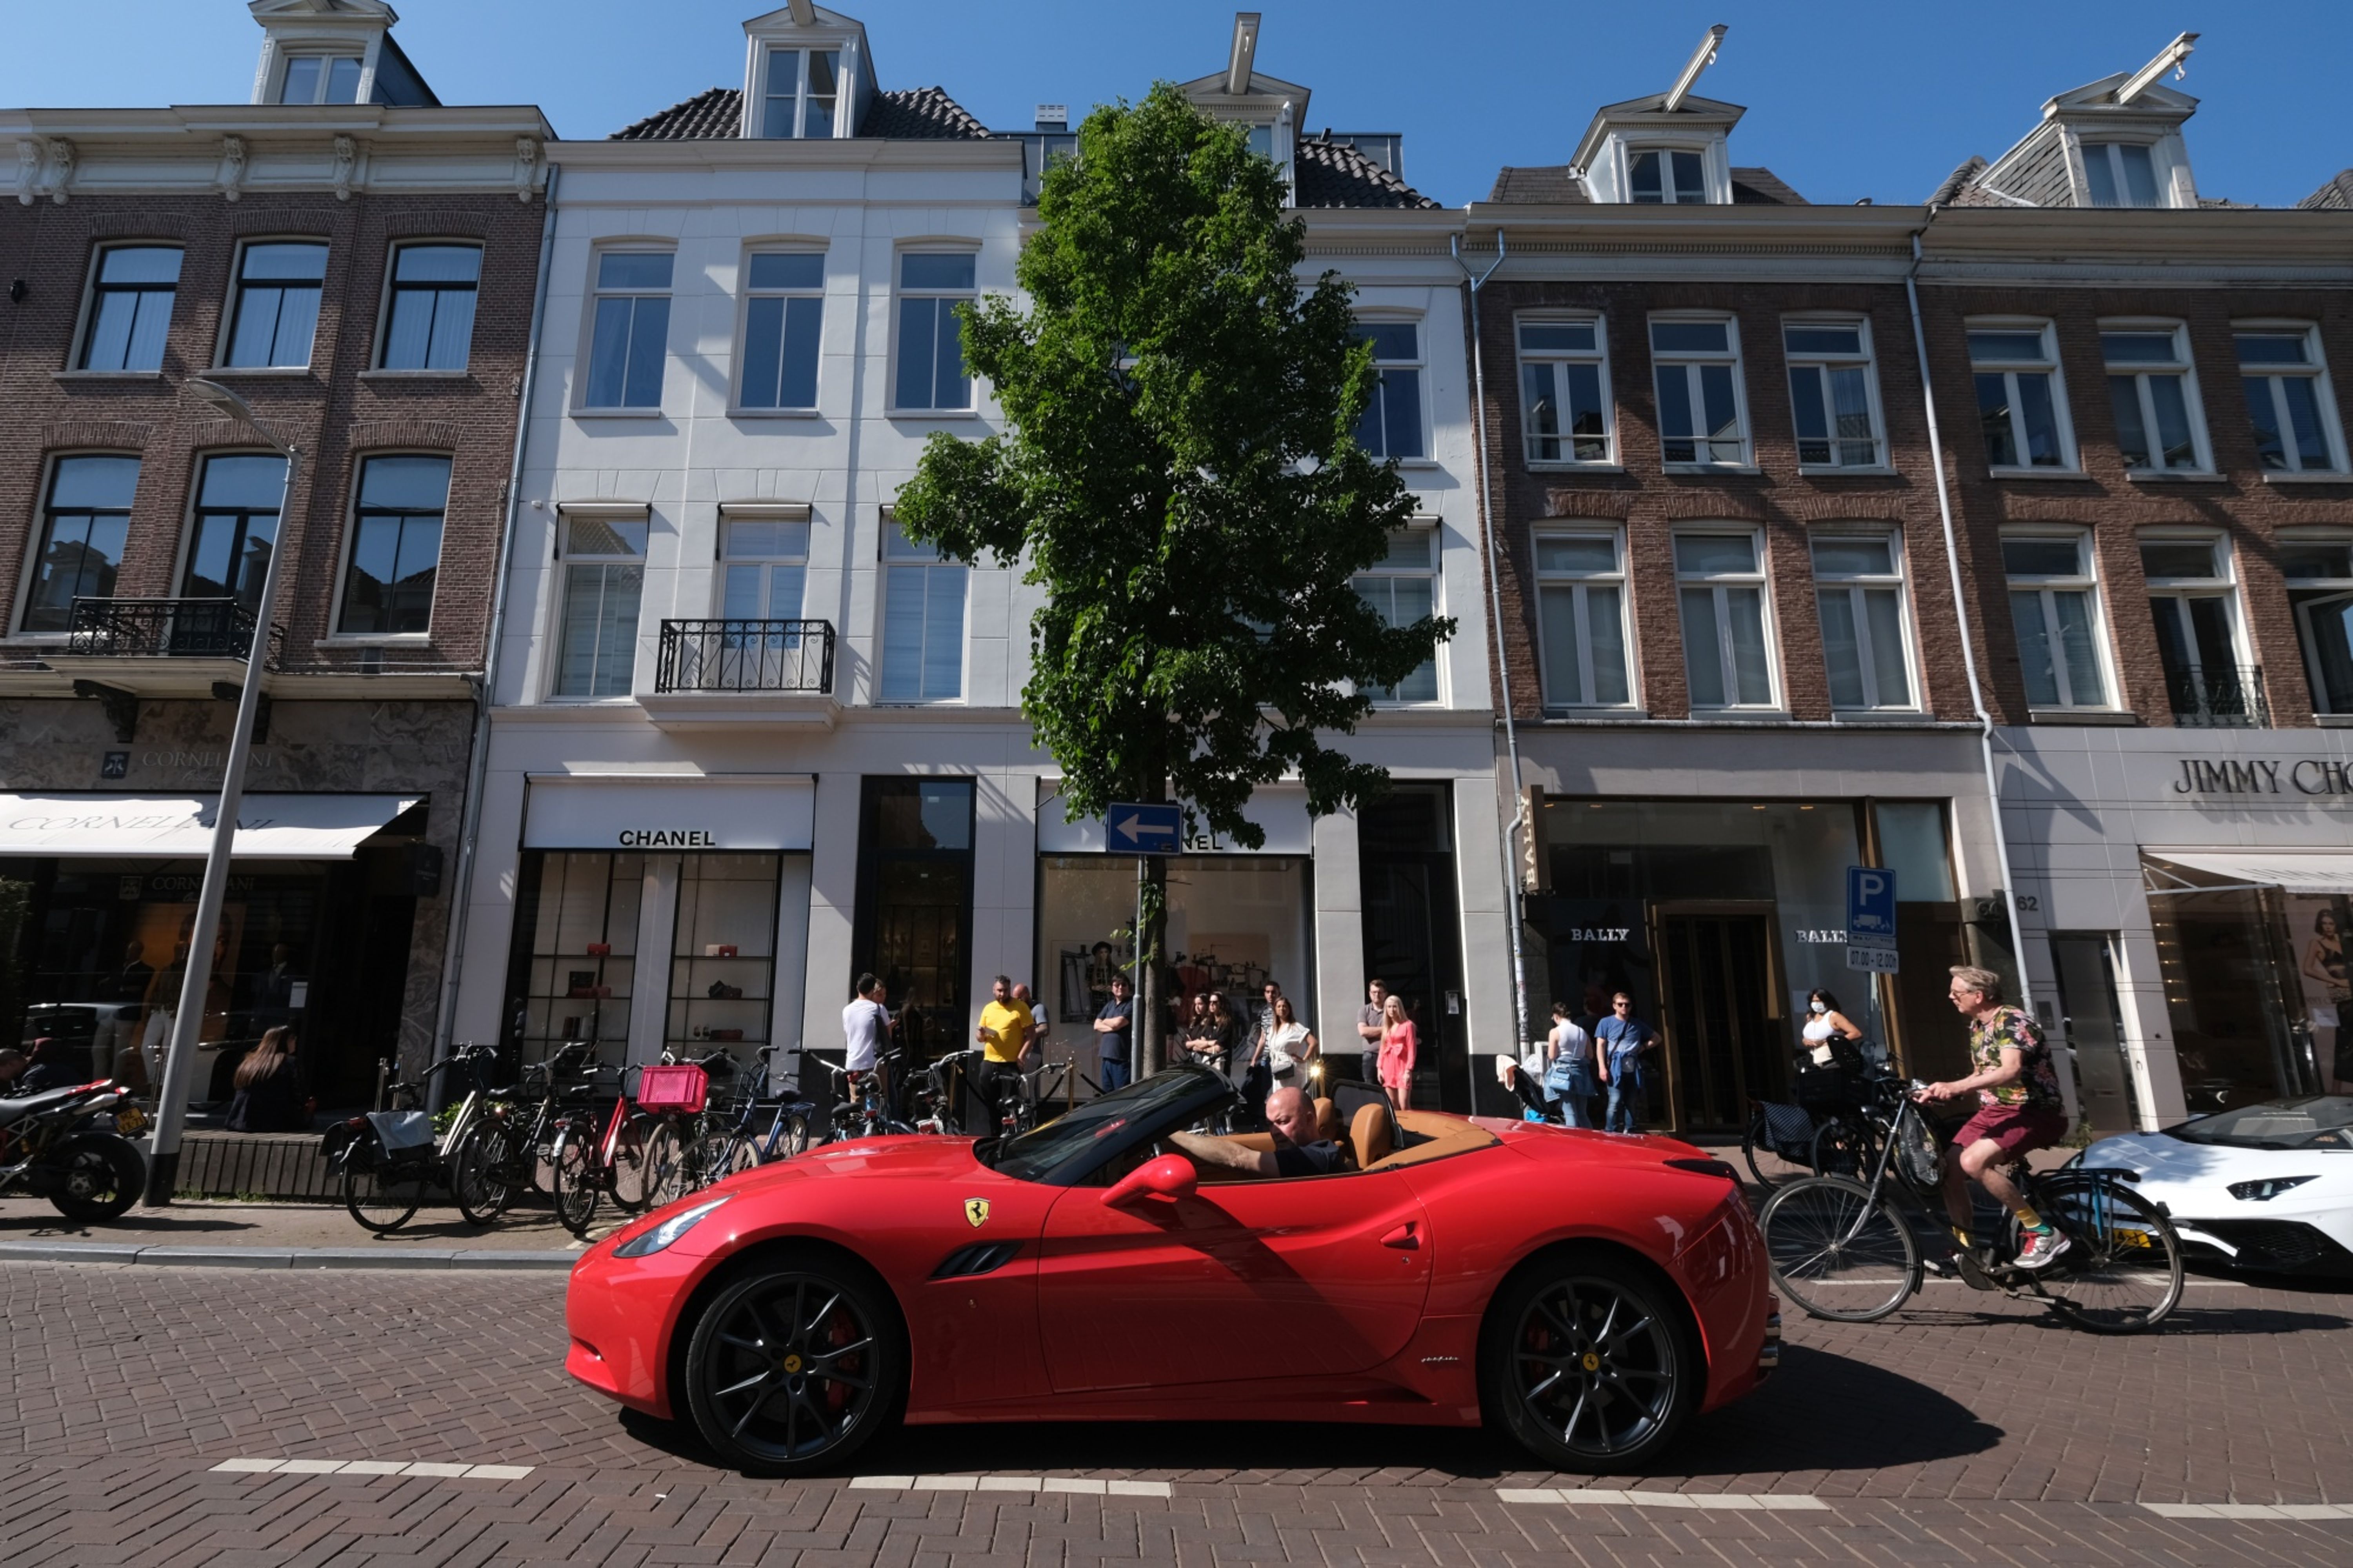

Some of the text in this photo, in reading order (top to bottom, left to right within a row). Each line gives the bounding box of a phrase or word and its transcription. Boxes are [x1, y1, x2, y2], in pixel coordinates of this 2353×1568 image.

[142, 751, 272, 767] CORNELNI
[2175, 759, 2353, 795] JIMMY CH
[619, 830, 716, 846] CHANEL
[1182, 835, 1223, 850] NEL
[1520, 795, 1535, 885] BALLY
[151, 877, 255, 890] CORNANI
[1860, 873, 1884, 906] P
[2017, 896, 2038, 911] 62
[1571, 928, 1630, 941] BALLY
